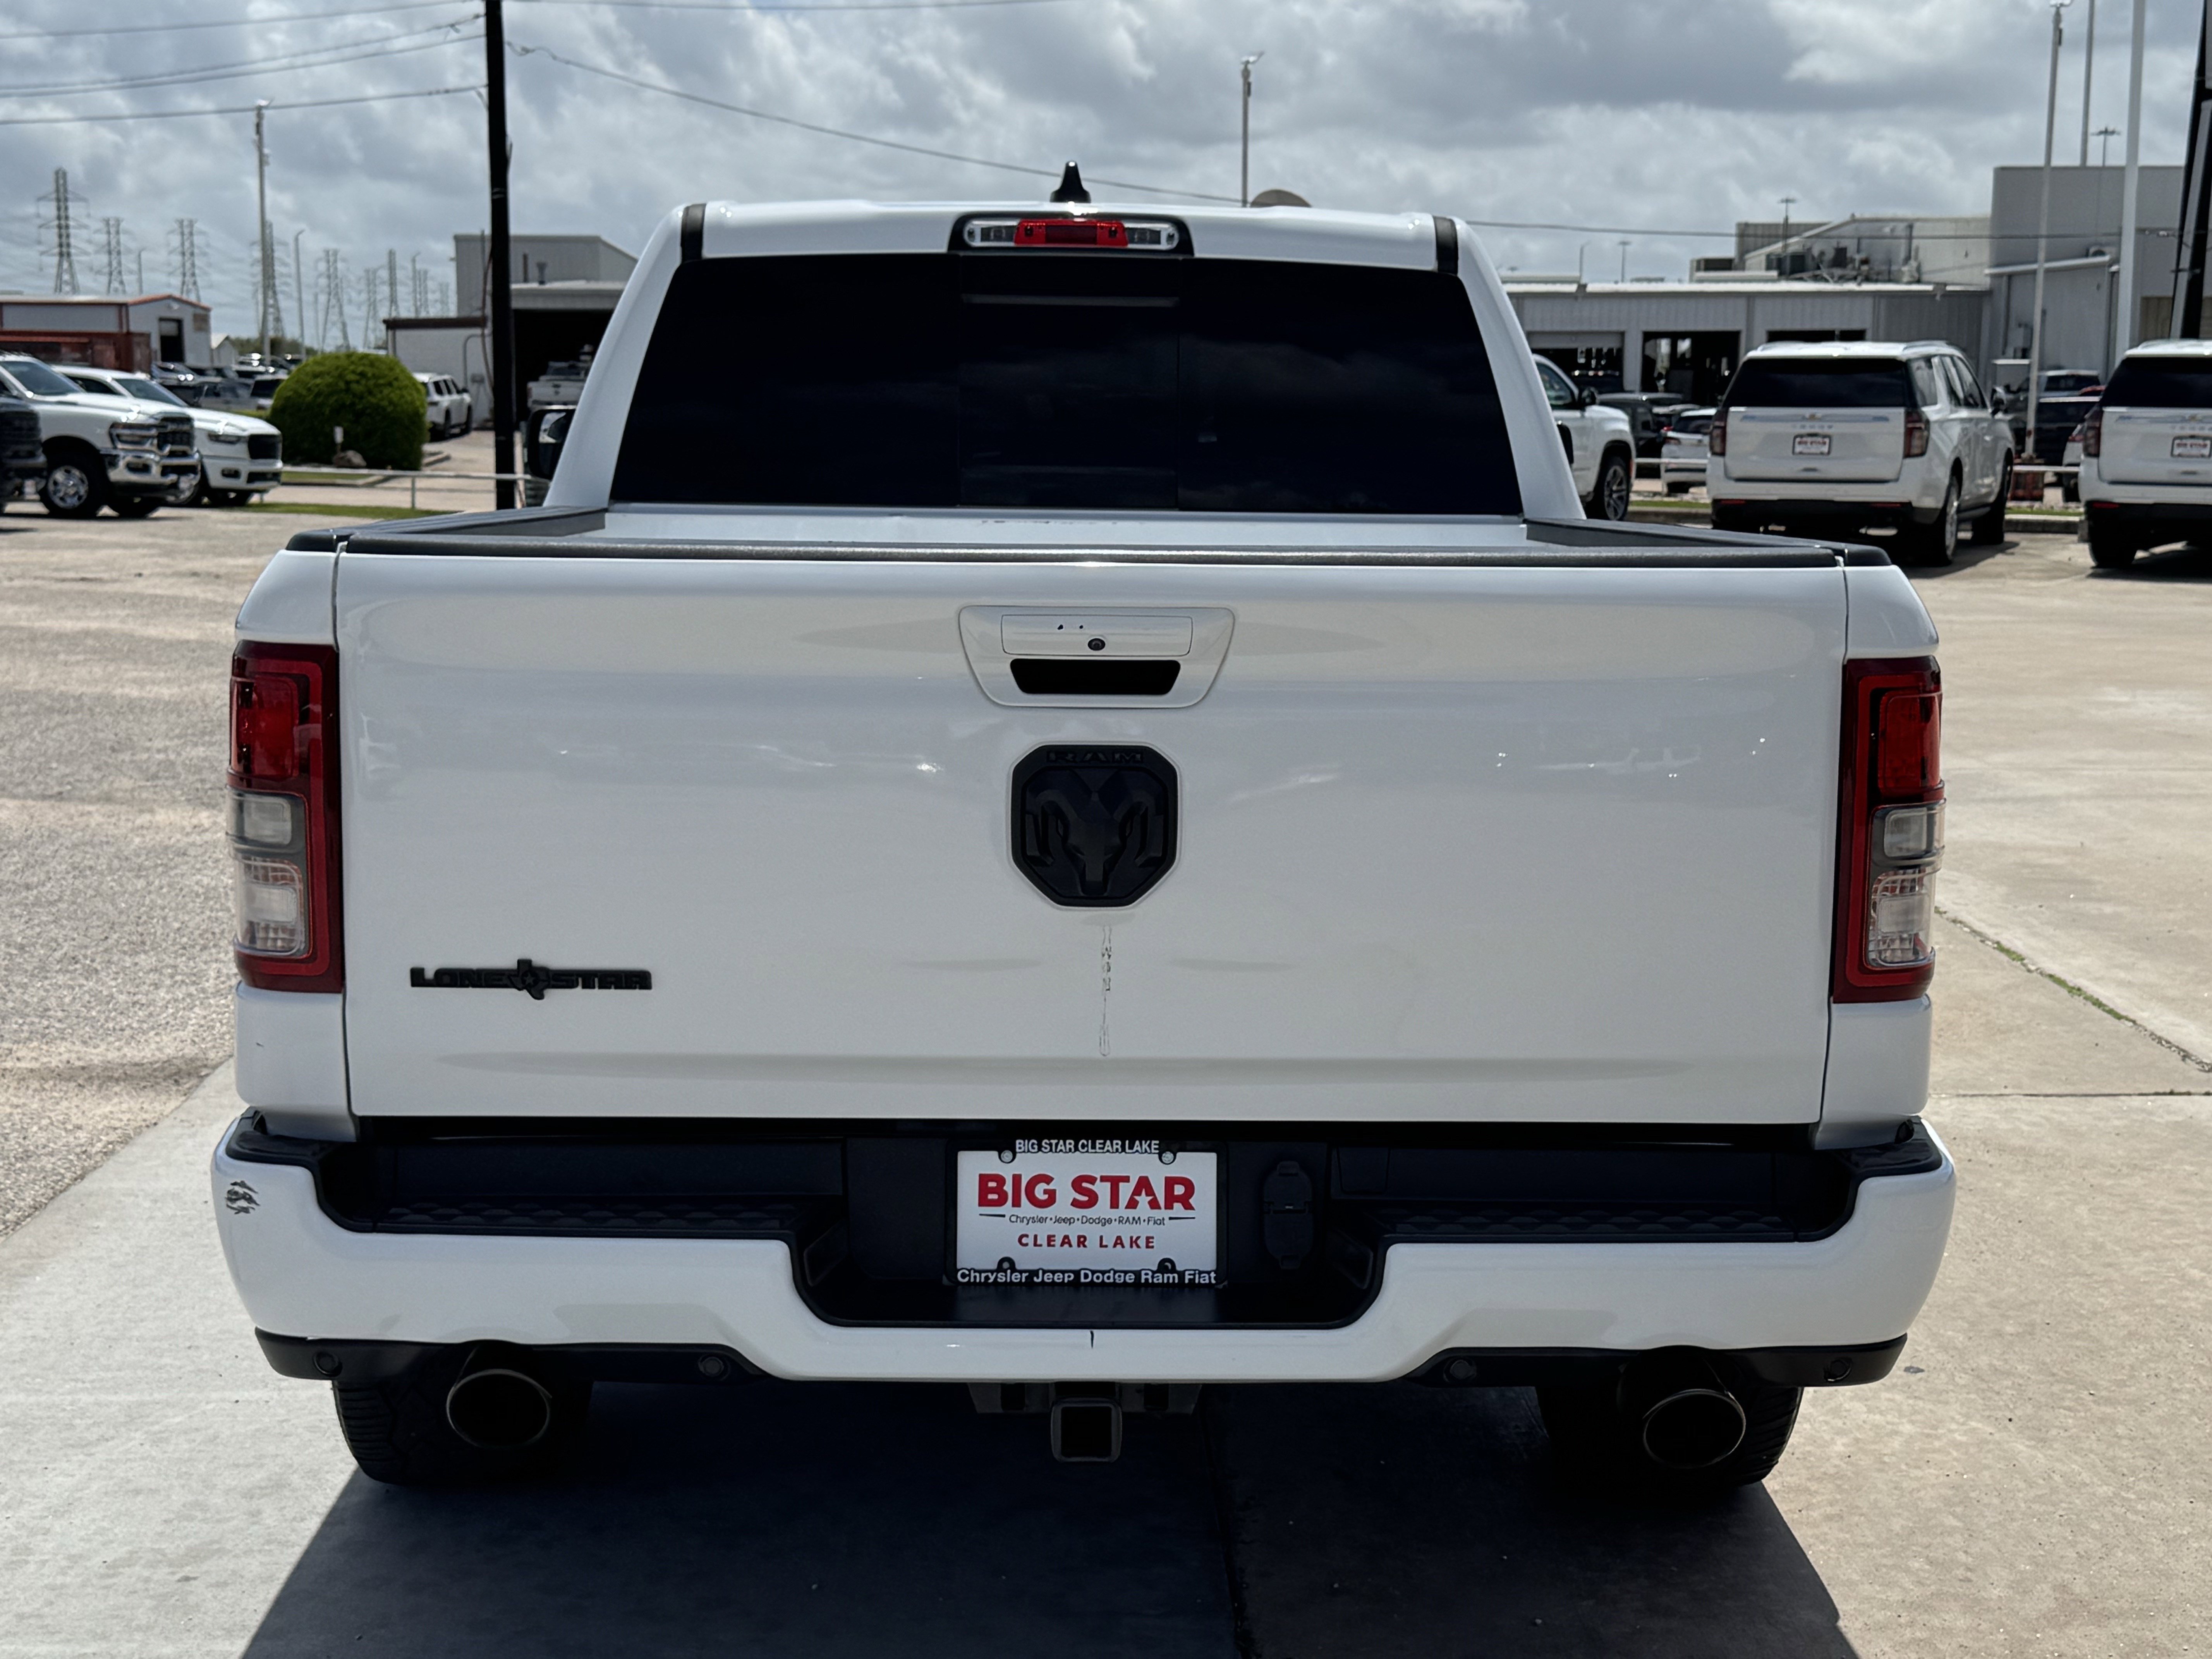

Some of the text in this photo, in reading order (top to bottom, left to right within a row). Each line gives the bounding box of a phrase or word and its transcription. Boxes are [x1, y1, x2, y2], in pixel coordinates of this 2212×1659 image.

[1046, 751, 1144, 763] RAM
[410, 967, 652, 990] LONE STAR
[1015, 1139, 1159, 1153] BIG STAR CLEAR LAKE
[978, 1173, 1196, 1211] BIG STAR
[1017, 1233, 1155, 1249] CLEAR LAKE
[957, 1269, 1217, 1284] Chrysler Jeep Dodge Ram Fiat
